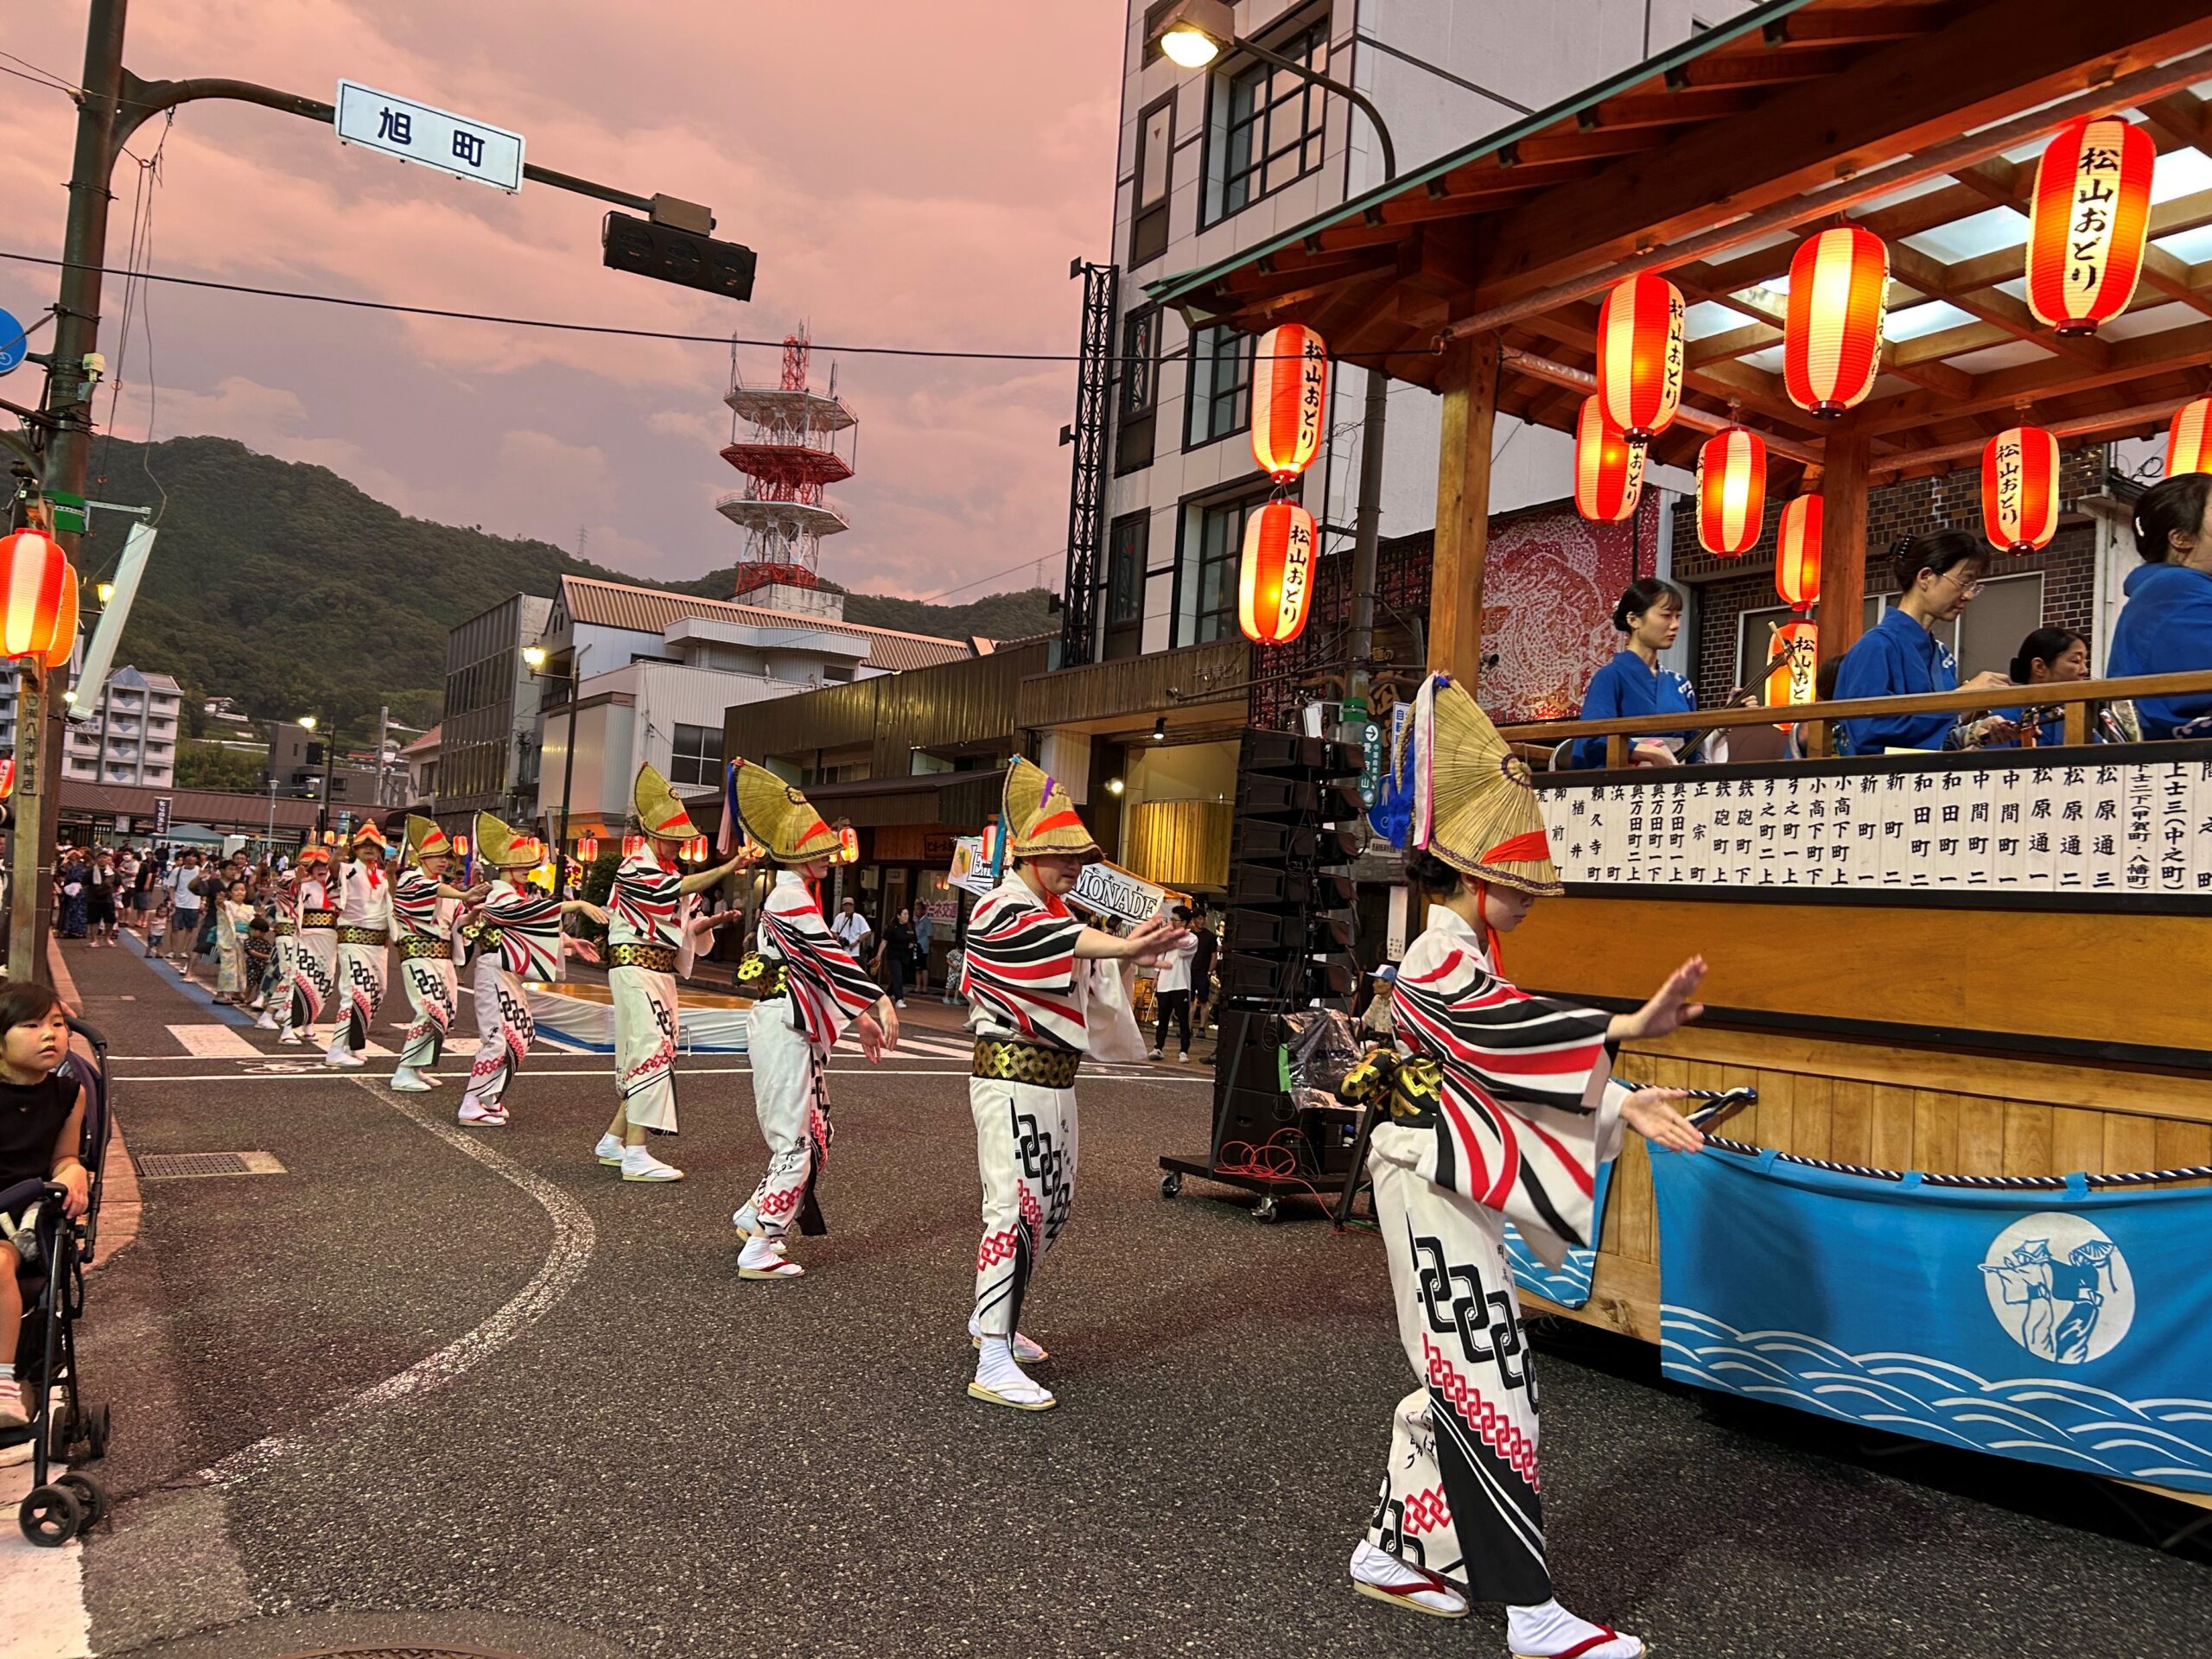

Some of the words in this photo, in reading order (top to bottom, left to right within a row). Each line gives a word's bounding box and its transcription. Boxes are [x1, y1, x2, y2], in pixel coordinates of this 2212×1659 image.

[378, 106, 486, 168] 旭町
[2074, 147, 2120, 292] 松山おどり
[1302, 340, 1325, 448] 松山おどり
[1995, 443, 2020, 525] 松山おどり
[1283, 525, 1311, 623] 松山おどり
[1794, 636, 1815, 705] 松山おど
[1607, 785, 1624, 881] 浜町
[1627, 783, 1644, 881] 奥万田町二上
[1648, 782, 1665, 882] 奥万田町一下
[1669, 781, 1687, 882] 奥万田町一上
[1690, 781, 1709, 883] 正宗町
[1713, 779, 1732, 884] 鉄砲町上
[1735, 779, 1755, 884] 鉄砲町下
[1758, 779, 1777, 885] 弓之町二上
[1782, 778, 1801, 885] 弓之町一上
[1806, 778, 1827, 886] 小高下町下
[1830, 774, 1853, 886] 小高下町上
[1857, 775, 1878, 881] 新町一
[1883, 772, 1906, 884] 新町二
[1910, 773, 1934, 887] 和田町二
[1939, 772, 1962, 883] 和田町一
[1967, 769, 1991, 885] 中間町二
[1998, 769, 2021, 883] 中間町一
[2028, 766, 2053, 880] 松原通一
[2060, 766, 2085, 887] 松原通二
[2092, 766, 2119, 888] 松原通三
